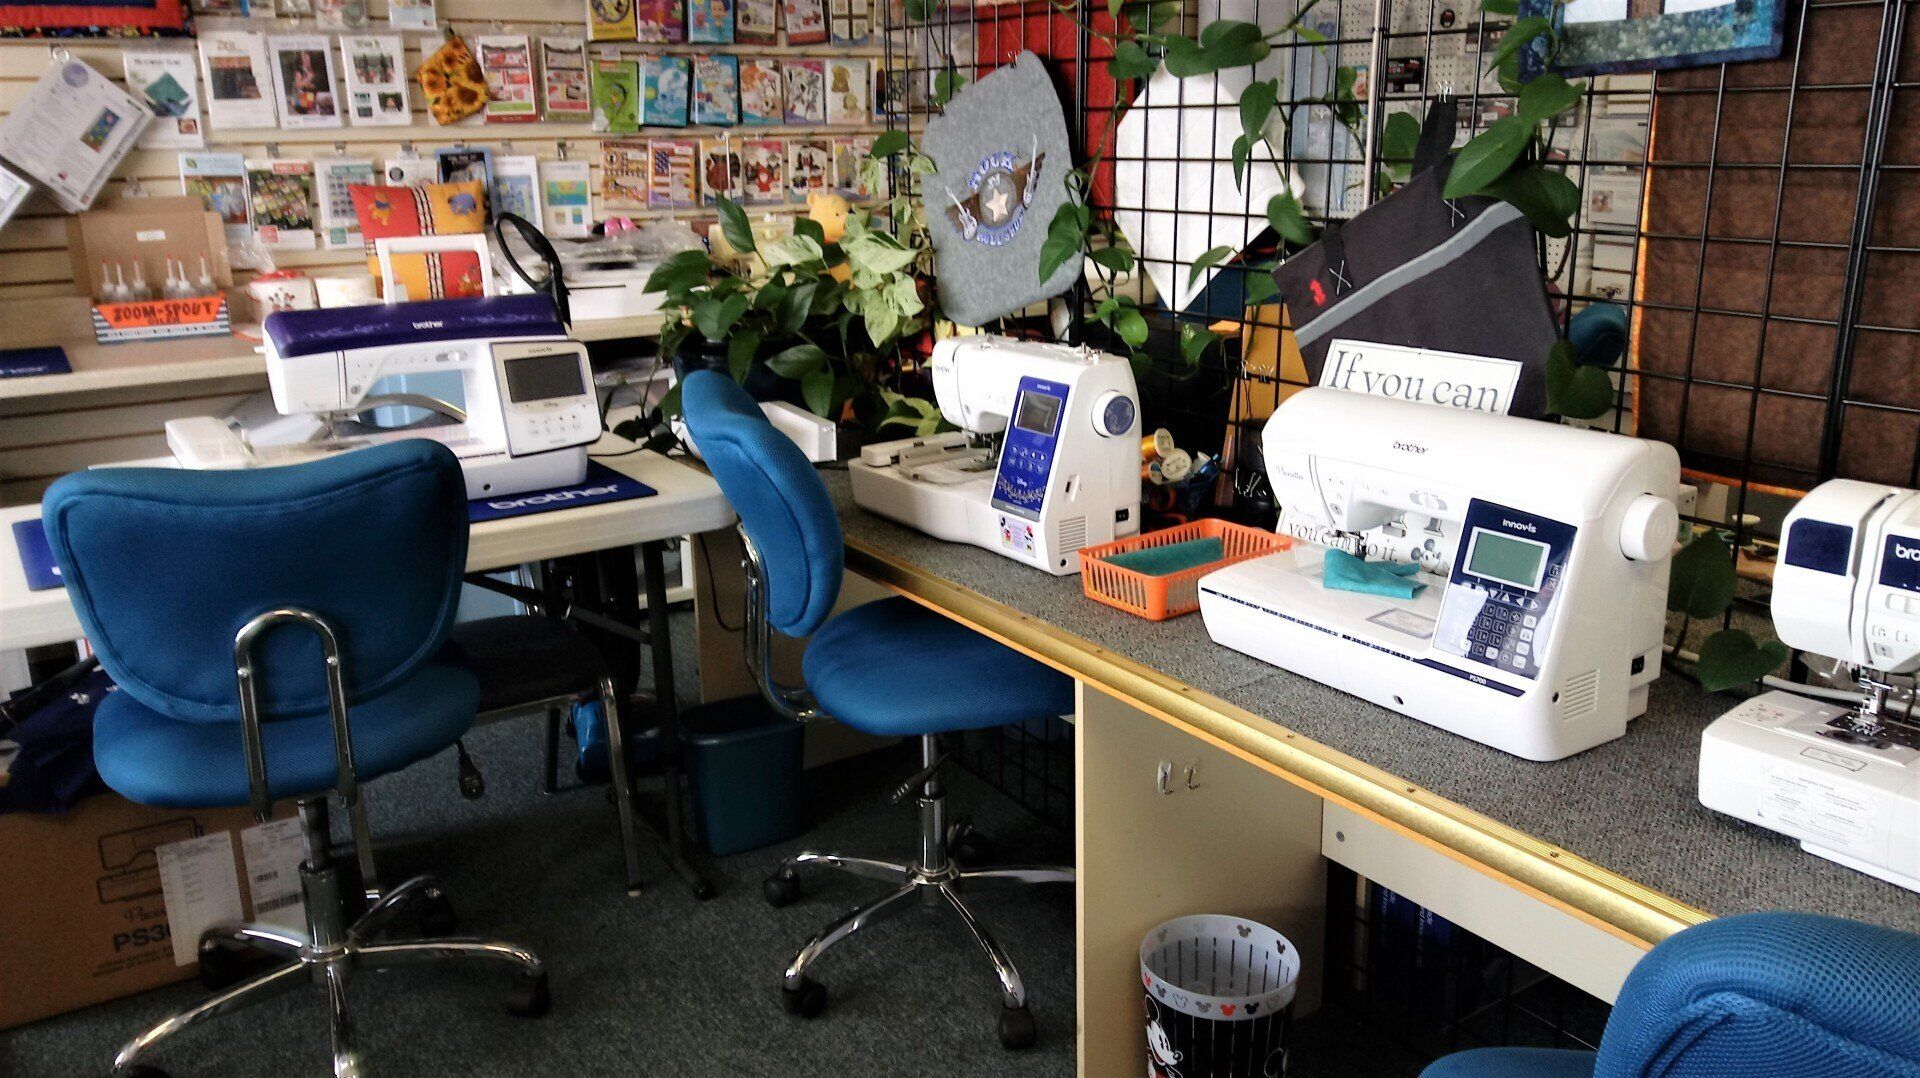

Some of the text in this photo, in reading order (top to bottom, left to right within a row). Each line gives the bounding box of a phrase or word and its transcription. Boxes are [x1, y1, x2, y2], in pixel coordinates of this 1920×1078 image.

[113, 302, 212, 322] ZOOM-SPOUT
[412, 320, 444, 330] brother
[1328, 350, 1500, 413] If you can
[487, 484, 618, 510] brother
[1289, 523, 1318, 542] you
